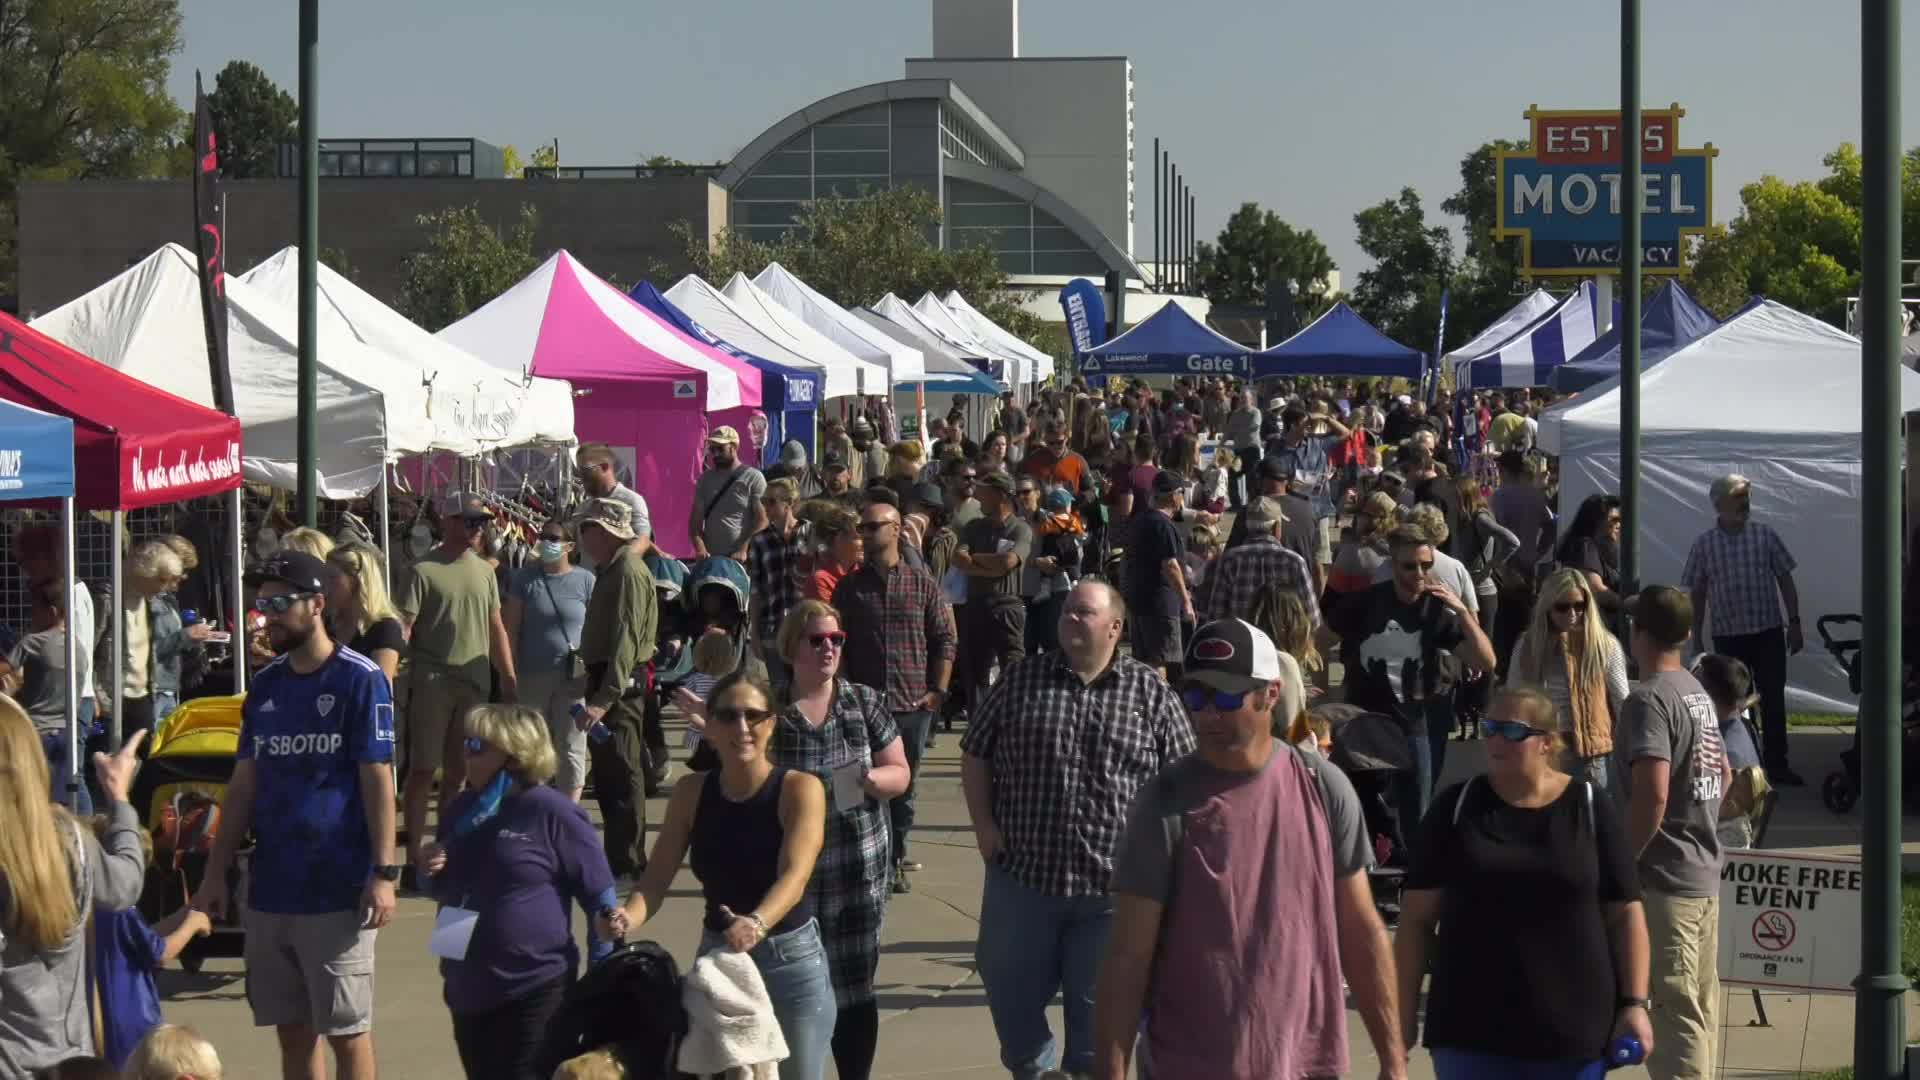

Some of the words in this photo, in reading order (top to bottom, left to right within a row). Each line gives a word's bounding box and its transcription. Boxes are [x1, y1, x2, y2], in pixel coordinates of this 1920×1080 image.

[1546, 125, 1664, 152] ESTS
[1513, 173, 1696, 215] MOTEL
[1573, 247, 1672, 263] VACCY
[1187, 354, 1234, 371] Gate
[1240, 355, 1250, 371] 1
[269, 734, 342, 755] SBOTOP
[1721, 862, 1790, 886] MOKE
[1798, 867, 1861, 891] FREE
[1736, 885, 1820, 910] EVENT
